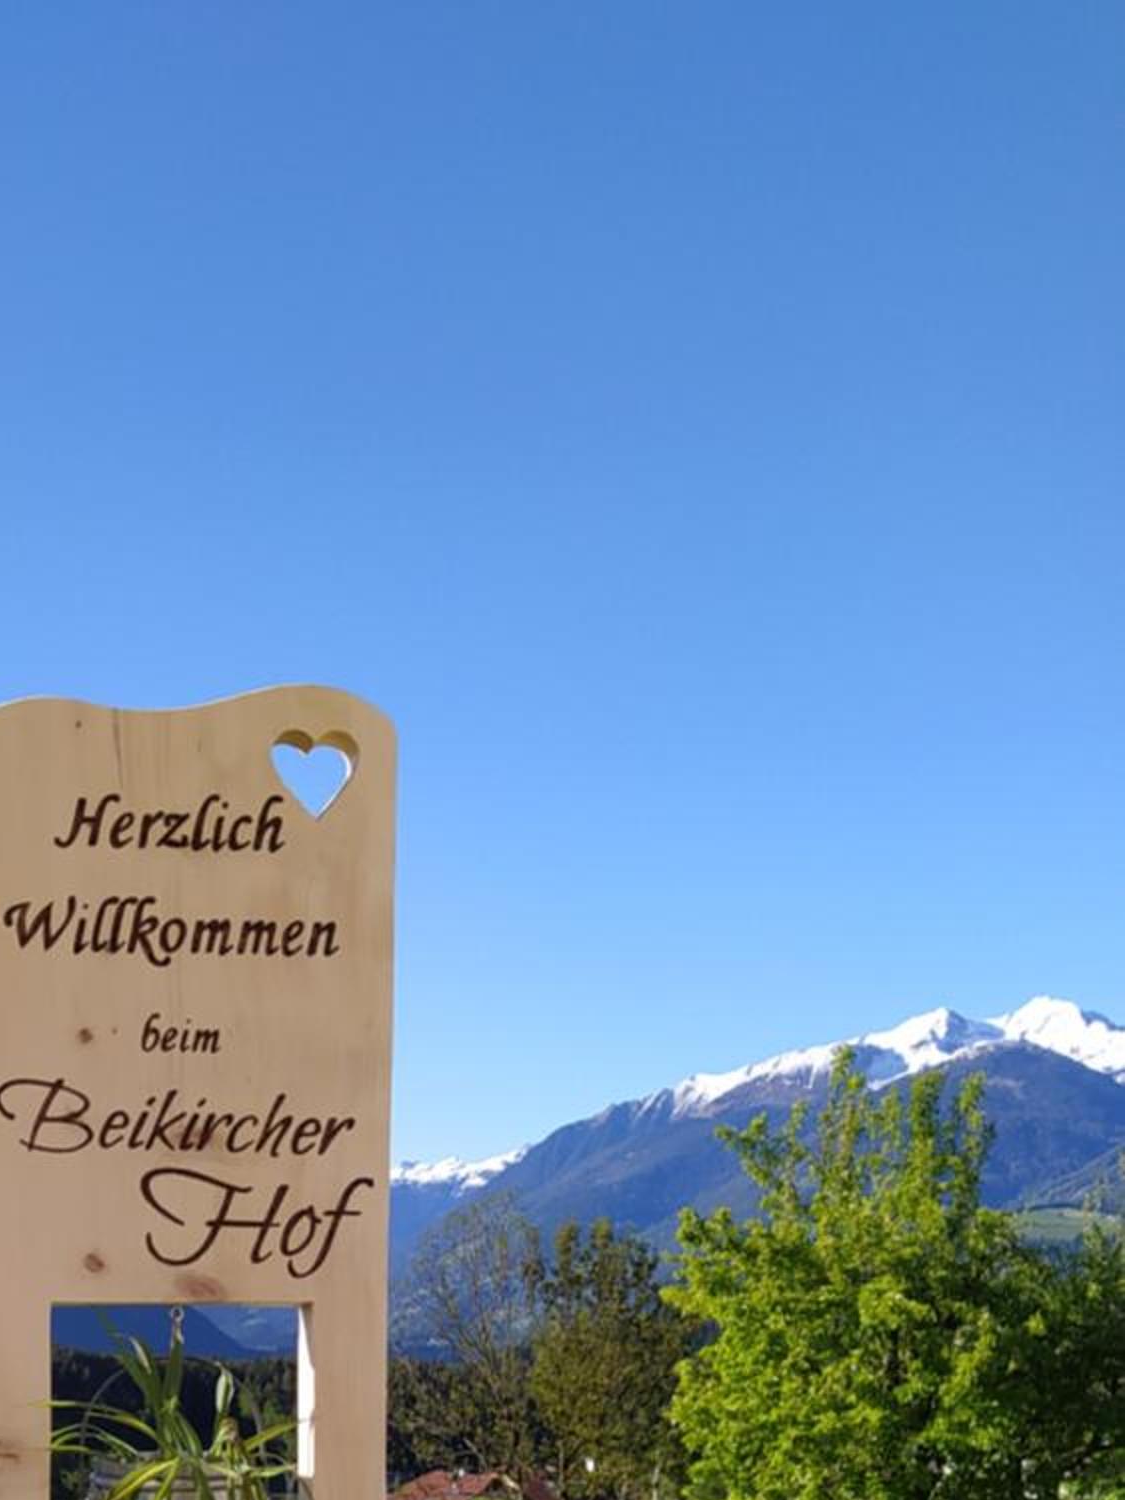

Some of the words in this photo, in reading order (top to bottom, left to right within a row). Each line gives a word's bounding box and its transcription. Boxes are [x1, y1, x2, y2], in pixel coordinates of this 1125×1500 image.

[53, 794, 285, 854] Herzlich
[3, 895, 340, 967] Willkommen
[140, 1013, 221, 1055] beim
[140, 1167, 374, 1279] Hof
